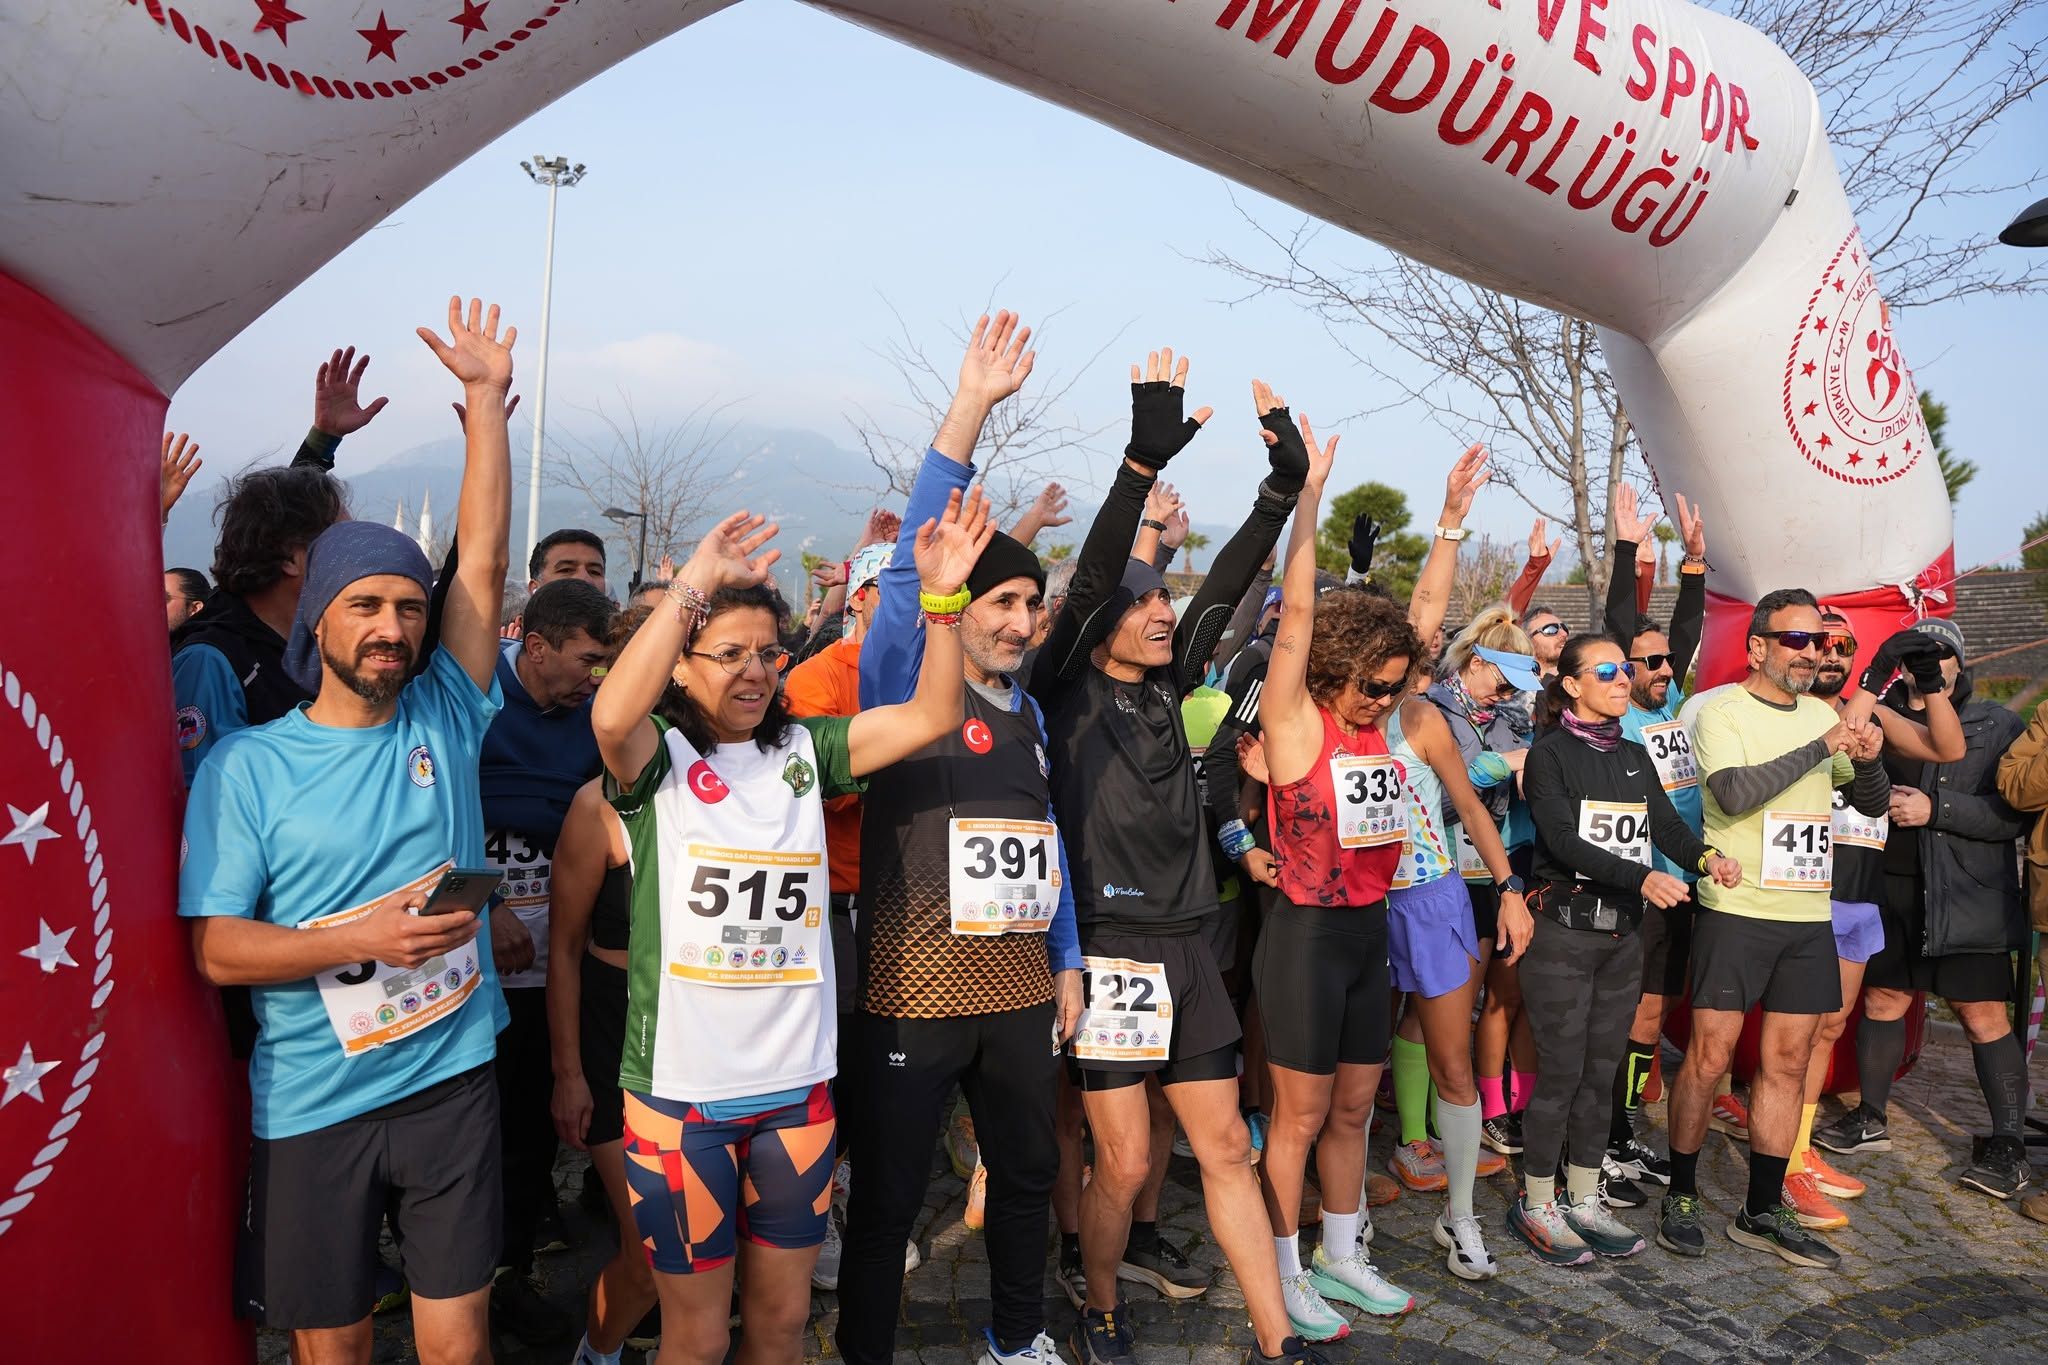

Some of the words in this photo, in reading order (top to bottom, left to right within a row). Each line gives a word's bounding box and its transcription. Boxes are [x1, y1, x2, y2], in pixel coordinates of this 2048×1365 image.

[1626, 23, 1760, 153] SPOR
[1828, 364, 1854, 427] TÜRKİYE
[1652, 730, 1690, 760] 343
[1344, 767, 1401, 805] 333
[1588, 813, 1649, 844] 504
[1772, 824, 1829, 854] 415
[485, 832, 552, 865] 43
[963, 836, 1047, 880] 391
[687, 865, 809, 922] 515
